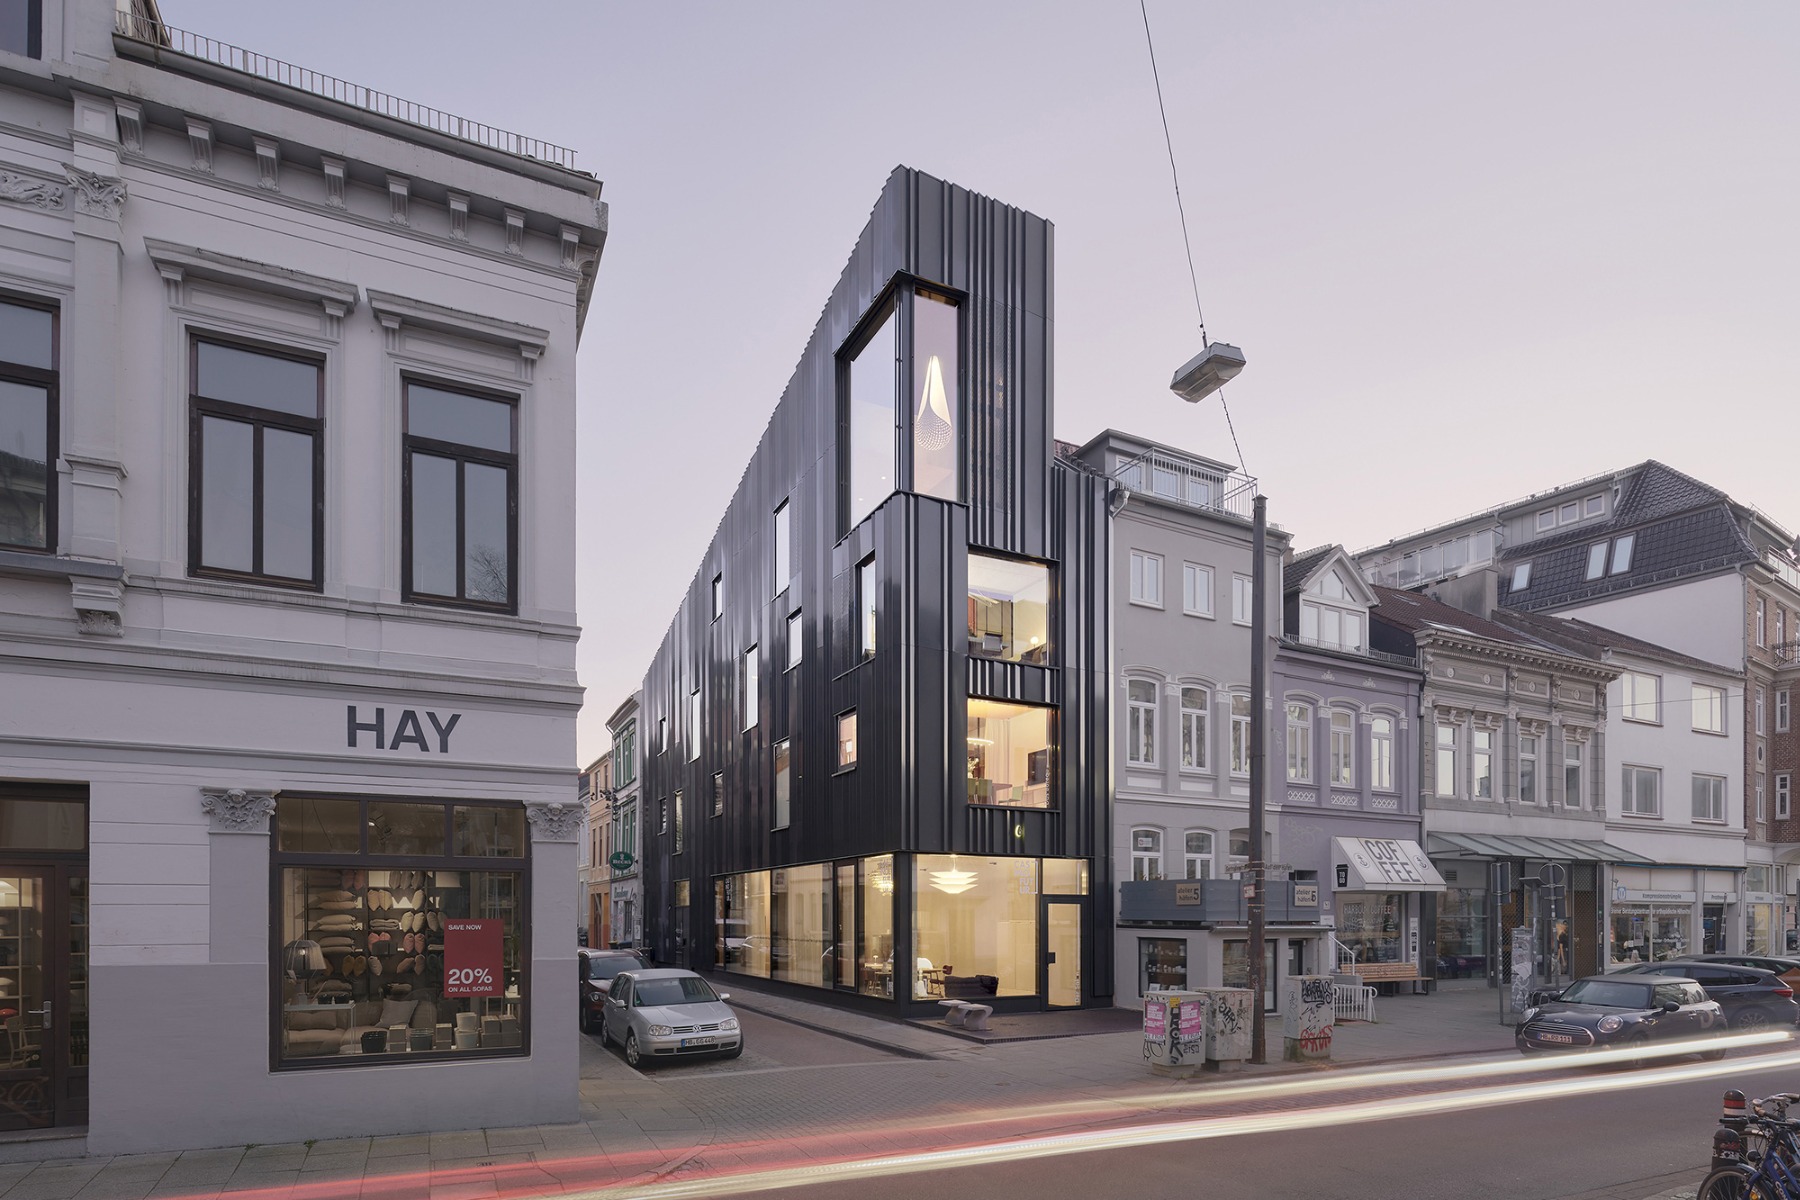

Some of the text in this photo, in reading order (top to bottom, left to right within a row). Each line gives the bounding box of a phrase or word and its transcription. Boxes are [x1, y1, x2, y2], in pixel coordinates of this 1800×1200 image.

[347, 705, 462, 753] HAY
[1364, 840, 1400, 861] COF
[1378, 861, 1421, 882] FEE
[448, 968, 493, 985] 20%
